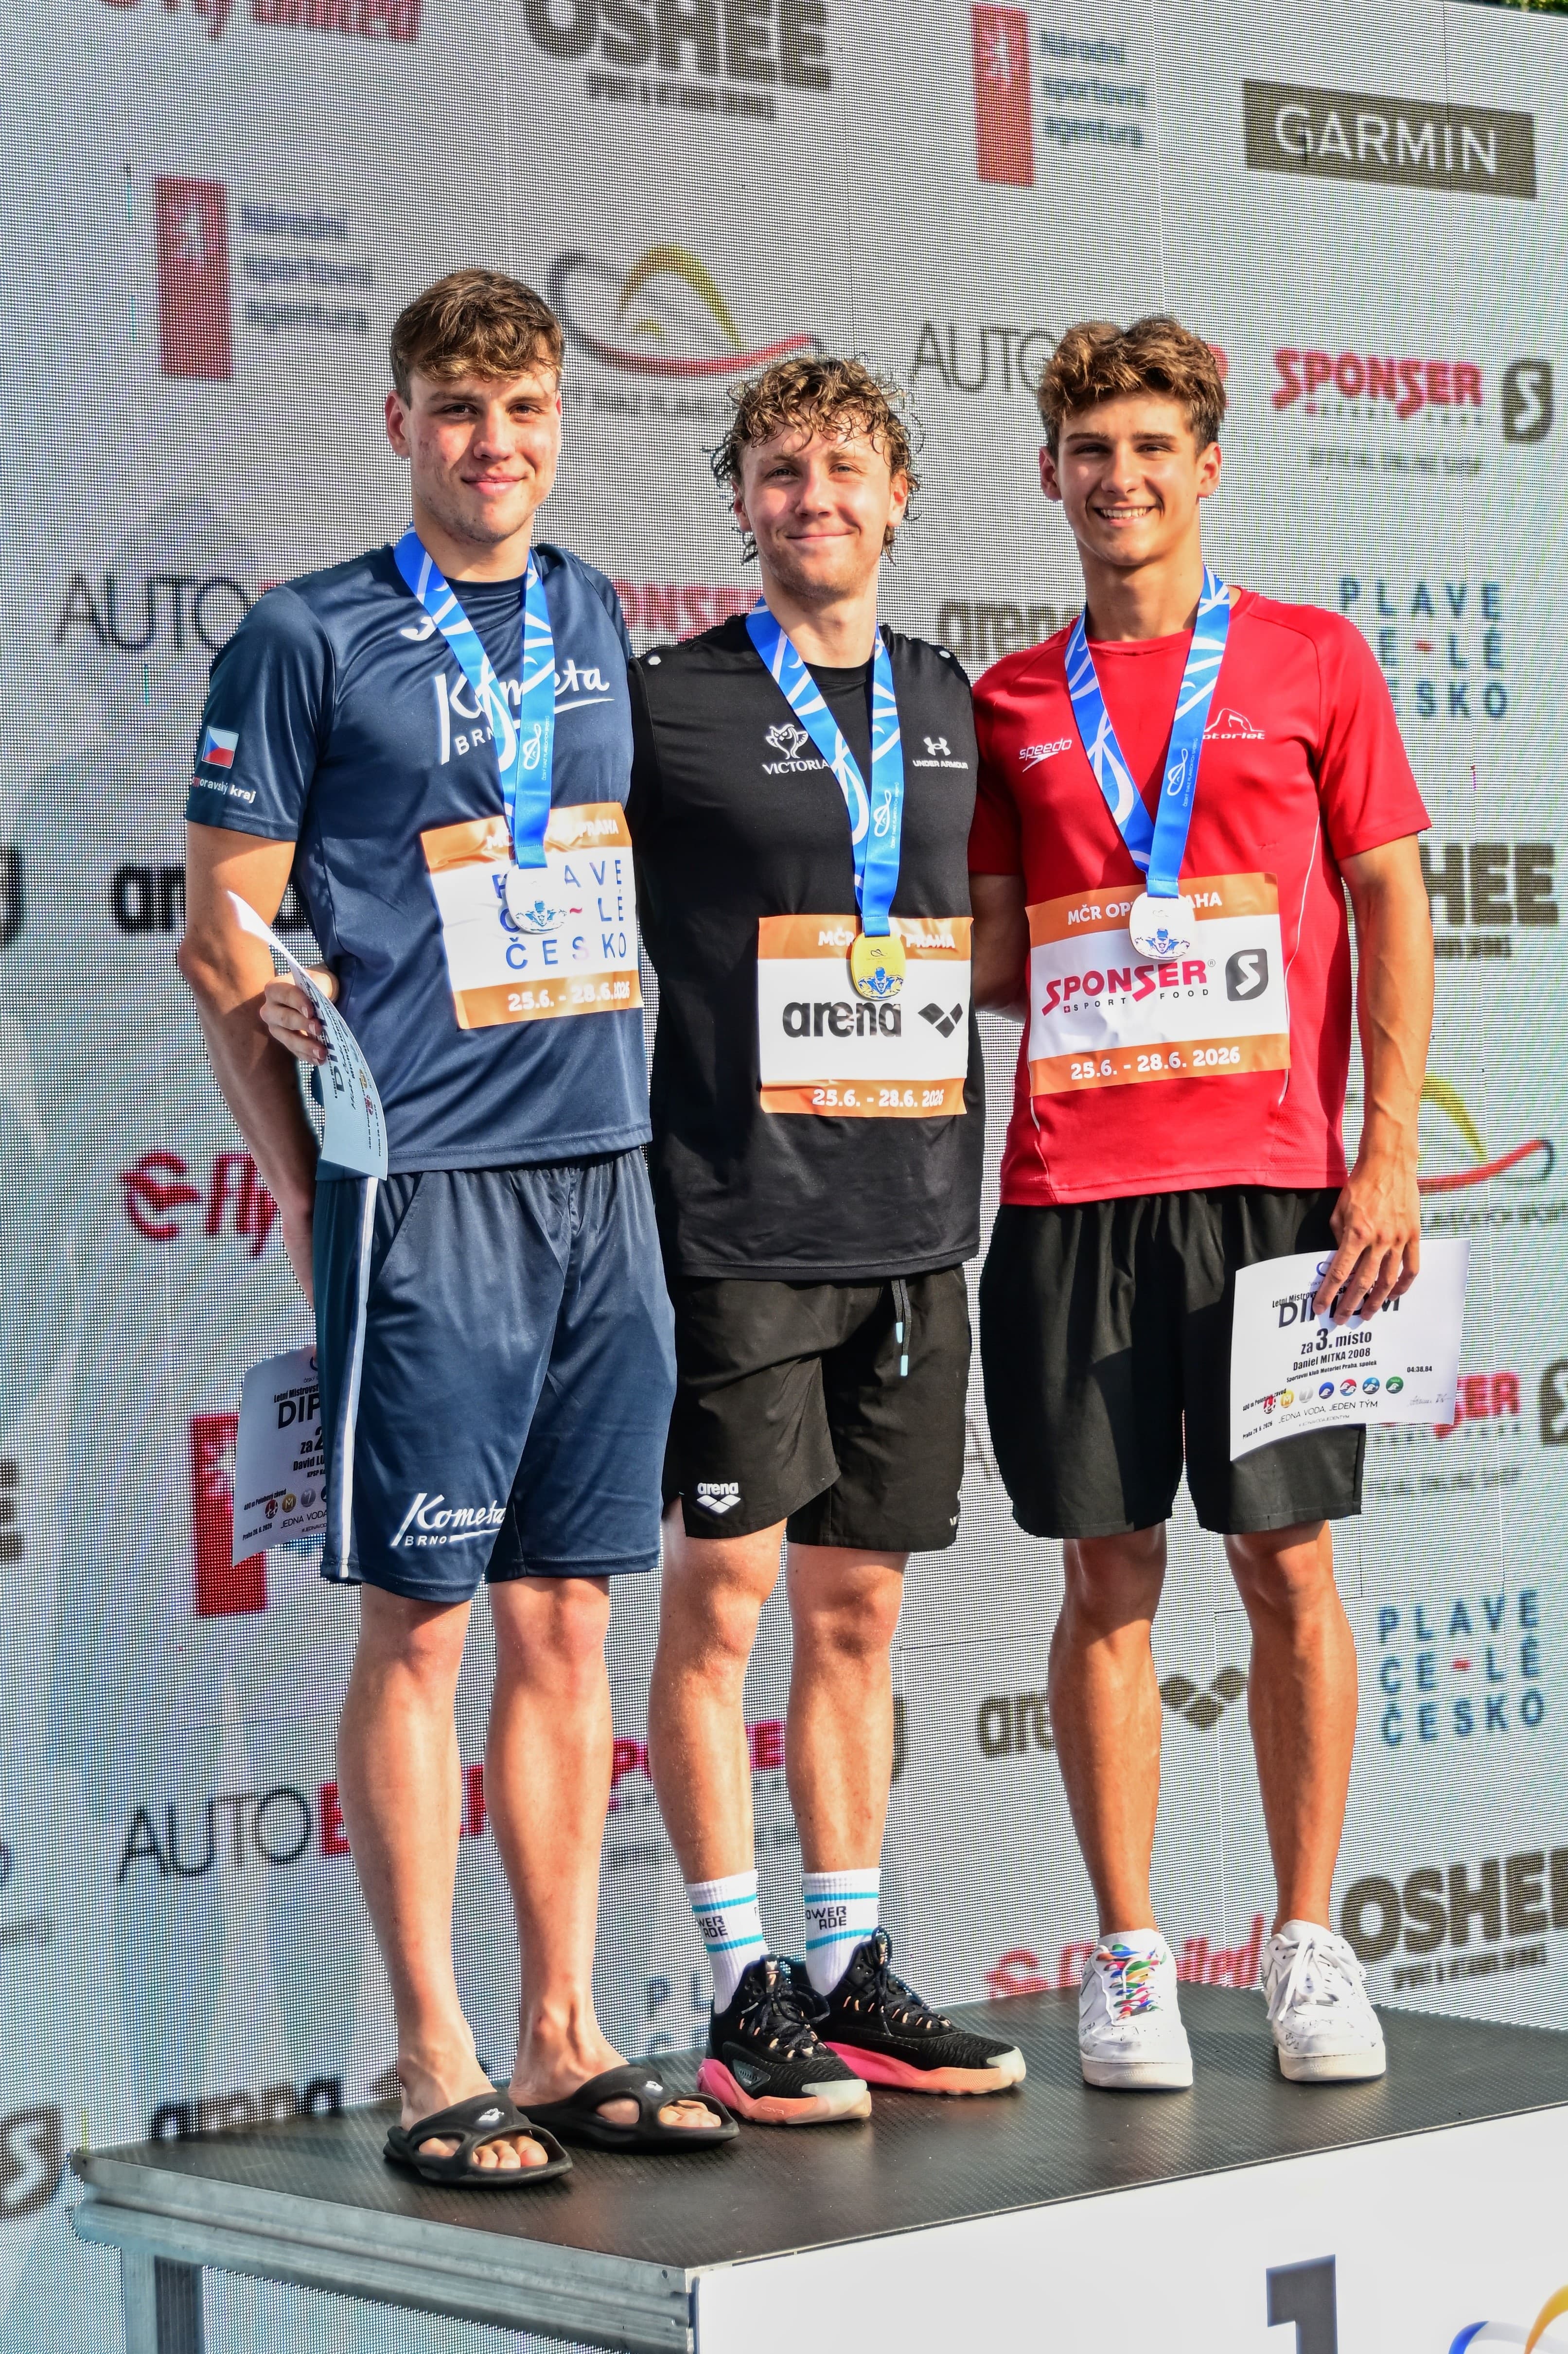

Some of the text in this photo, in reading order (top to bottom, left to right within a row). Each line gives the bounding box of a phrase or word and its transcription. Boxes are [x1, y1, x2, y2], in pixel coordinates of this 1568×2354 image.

[525, 0, 832, 91] OSHEE
[1275, 104, 1498, 175] GARMIN
[908, 319, 1057, 395] AUTO
[1272, 346, 1484, 421] SPONSER
[1340, 576, 1502, 621] PLAVE
[55, 571, 250, 652] AUTO
[1019, 738, 1073, 760] speedo
[762, 759, 829, 775] VICTORIA
[913, 760, 939, 768] UNDER
[229, 784, 256, 804] kraj
[1068, 903, 1101, 925] MČR
[506, 932, 627, 970] ČESKO
[905, 933, 955, 949] PRAHA
[1041, 960, 1207, 1017] SPONSER
[1073, 988, 1209, 1012] SPORT FOOD
[508, 989, 554, 1012] 25.6.
[783, 1001, 901, 1038] arena
[1071, 1059, 1117, 1080] 25.6.
[1137, 1052, 1187, 1072] 28.6.
[1193, 1046, 1240, 1067] 2026
[812, 1089, 861, 1107] 25.6.
[879, 1089, 918, 1107] 28.6.
[922, 1089, 945, 1107] 2026
[1272, 1297, 1288, 1308] Letní
[1301, 1328, 1372, 1355] za 3. místo
[1293, 1348, 1371, 1371] Daniel MITKA 2008
[274, 1391, 288, 1403] Letní
[1329, 1401, 1356, 1411] JEDEN
[1359, 1400, 1378, 1408] TÝM
[278, 1392, 320, 1429] DIP
[300, 1426, 323, 1455] za 2
[293, 1458, 315, 1471] David
[697, 1482, 739, 1495] arena
[281, 1515, 304, 1528] JEDNA
[390, 1493, 507, 1546] Kometa
[405, 1535, 447, 1546] BRNO
[1379, 1589, 1539, 1644] PLAVE
[1381, 1688, 1545, 1748] ČESKO
[806, 1906, 847, 1920] OWER
[819, 1916, 847, 1930] ADE
[704, 1925, 728, 1938] ADE
